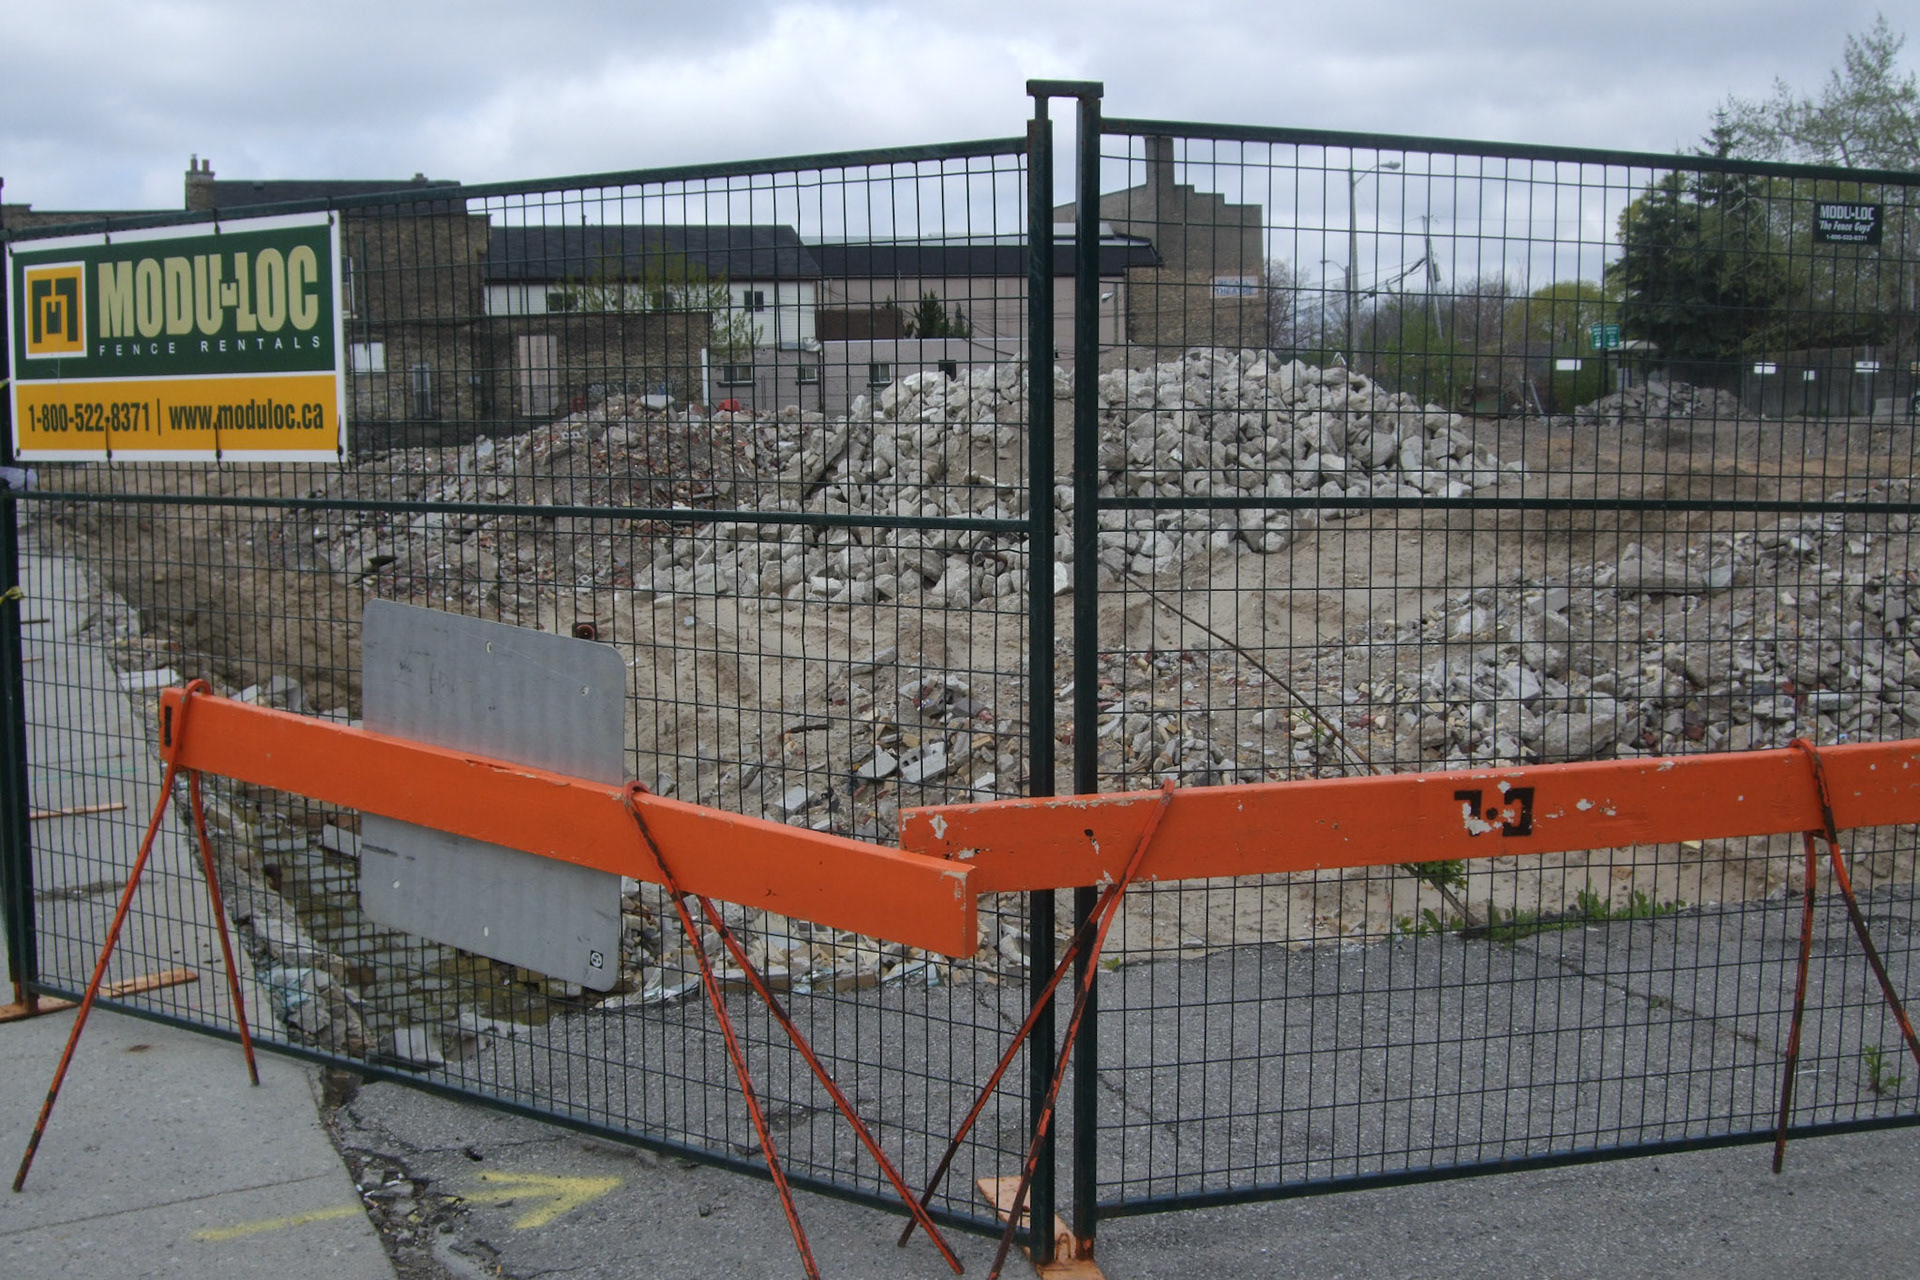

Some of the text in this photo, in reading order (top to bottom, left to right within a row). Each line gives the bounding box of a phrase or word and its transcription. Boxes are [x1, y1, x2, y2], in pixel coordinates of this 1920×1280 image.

[1820, 205, 1874, 220] MODU-LOC
[1833, 221, 1853, 231] Fence
[98, 245, 319, 338] MODU-LOC
[99, 336, 320, 356] FENCE RENTALS
[28, 398, 324, 433] 1-800-522-8371 www.moduloc.ca
